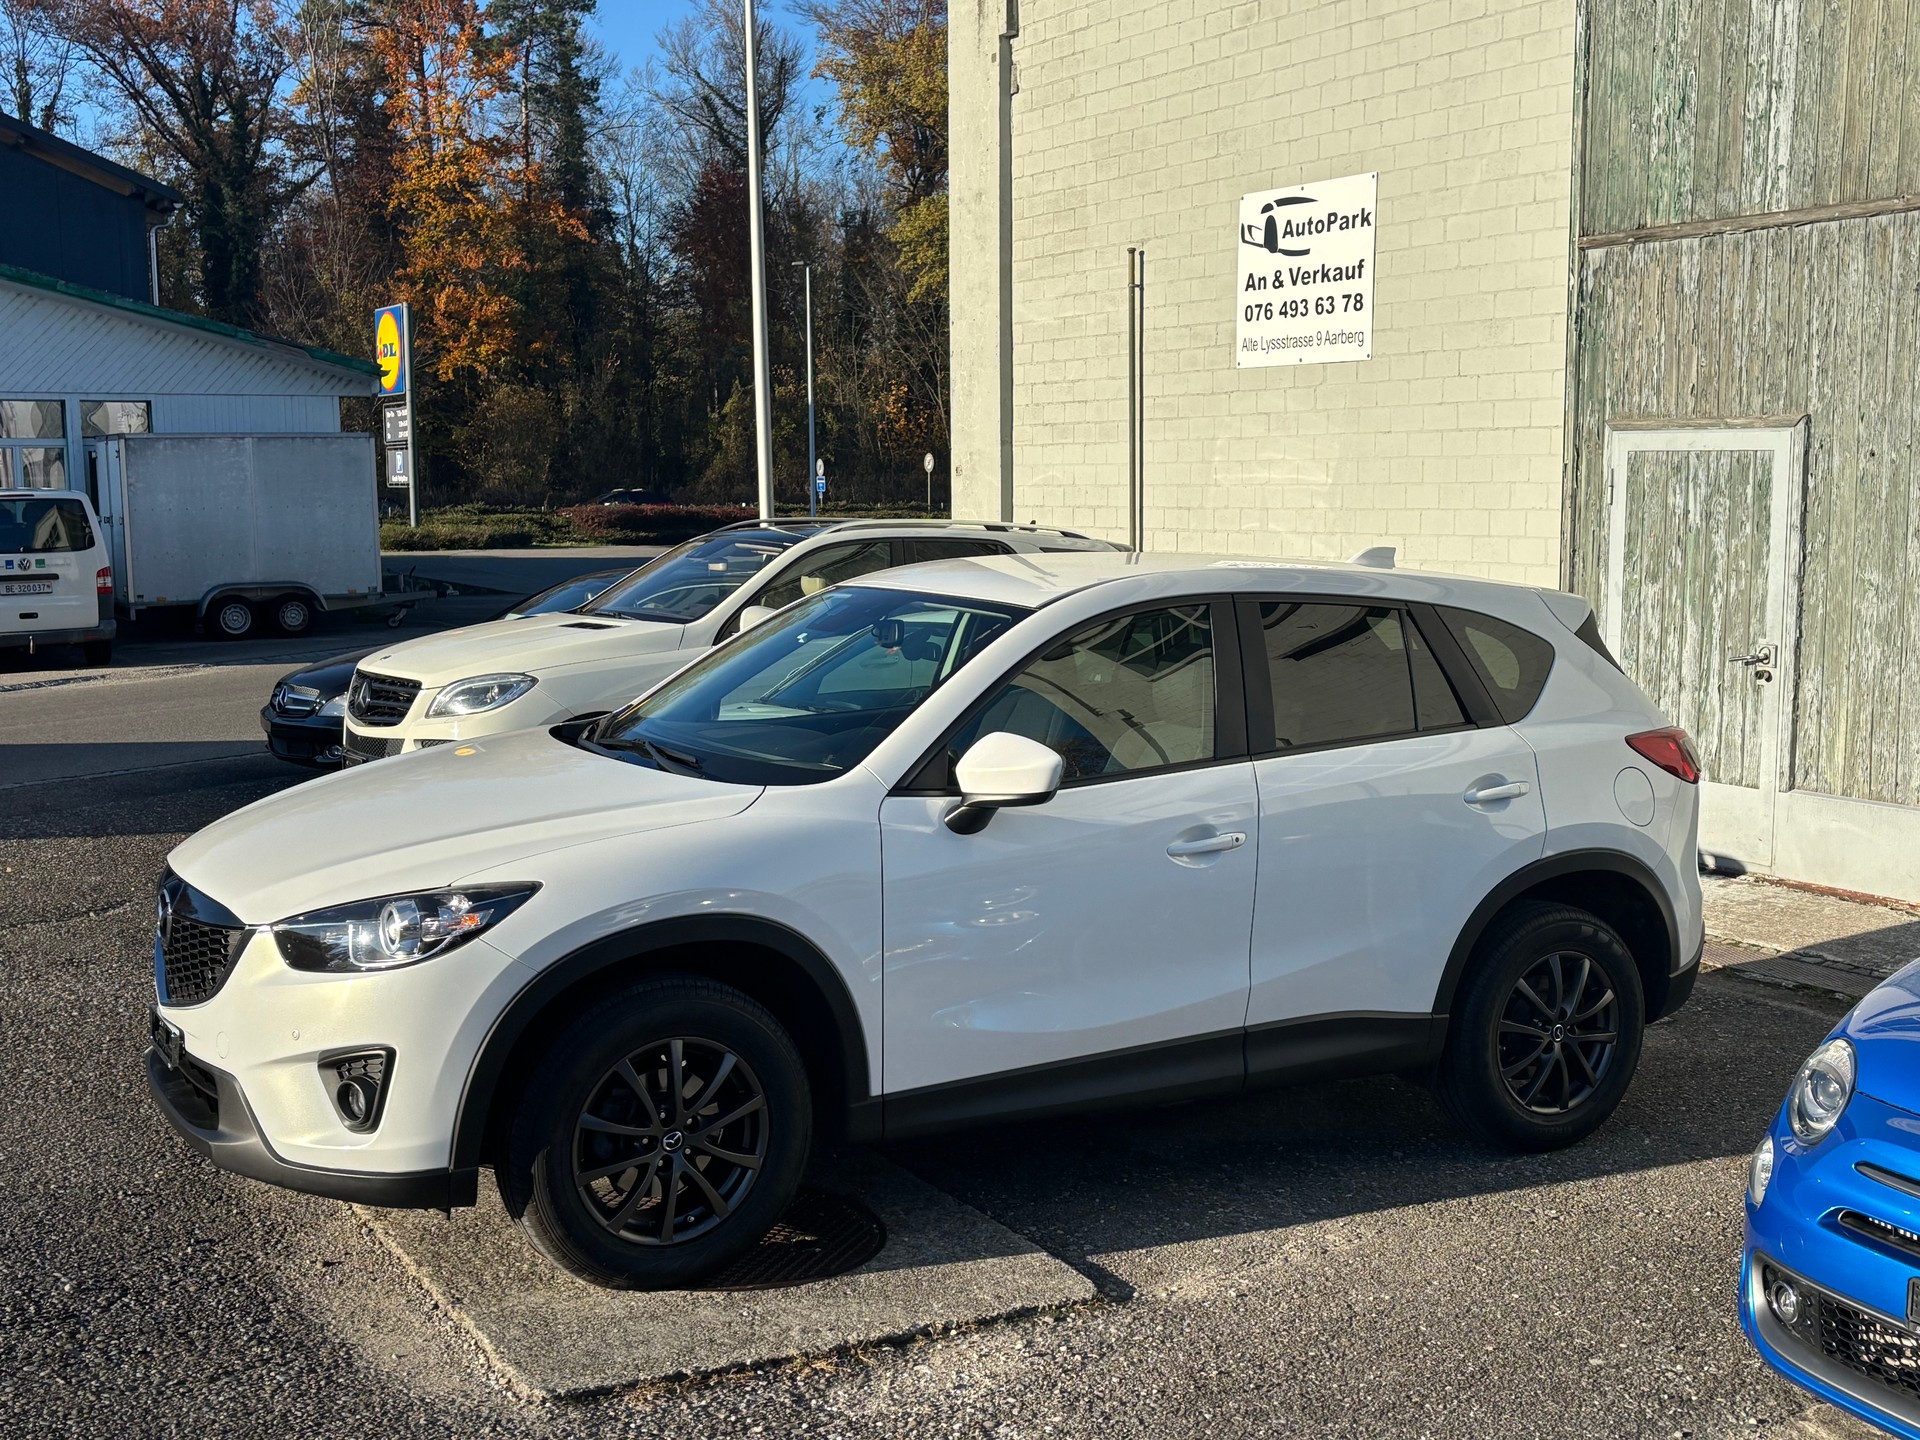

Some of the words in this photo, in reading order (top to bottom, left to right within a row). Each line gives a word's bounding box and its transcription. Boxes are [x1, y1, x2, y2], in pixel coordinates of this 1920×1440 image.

[1282, 208, 1372, 239] AutoPark
[1245, 273, 1267, 291] An
[1272, 270, 1284, 289] &
[1289, 259, 1365, 286] Verkauf
[1245, 303, 1273, 322] 076
[1279, 299, 1309, 318] 493
[1315, 296, 1335, 315] 63
[1342, 293, 1364, 313] 78
[1242, 337, 1258, 352] Alte
[1261, 334, 1313, 354] Lyssstrasse
[1316, 331, 1322, 346] 9
[1324, 329, 1364, 347] Aarberg
